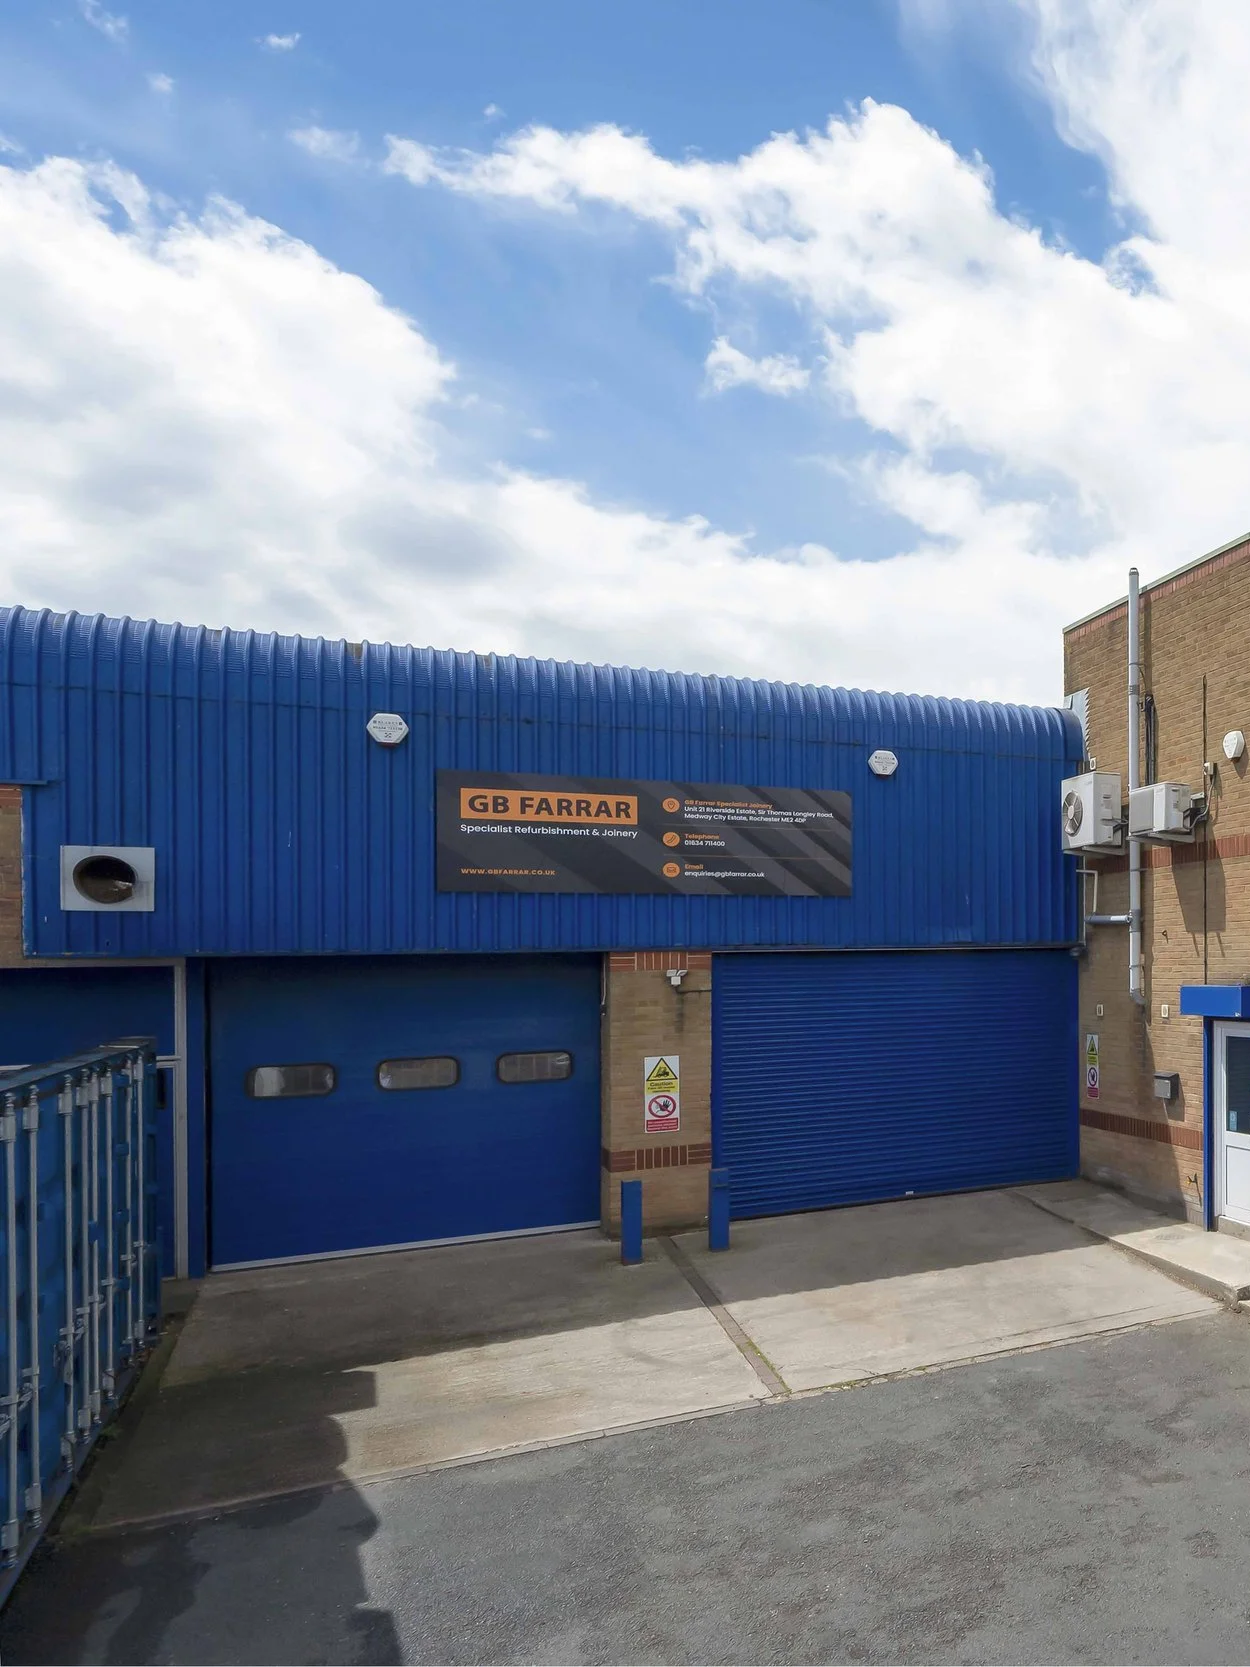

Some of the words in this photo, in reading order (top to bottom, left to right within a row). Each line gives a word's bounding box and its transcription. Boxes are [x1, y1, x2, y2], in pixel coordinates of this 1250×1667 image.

[468, 794, 510, 814] GB
[520, 796, 632, 819] FARRAR
[684, 813, 712, 821] Medway
[460, 824, 512, 834] Specialist
[514, 826, 590, 836] Refurbishment
[602, 829, 638, 839] Joinery
[460, 868, 556, 876] WWW.GBFARRAR.CO.UK
